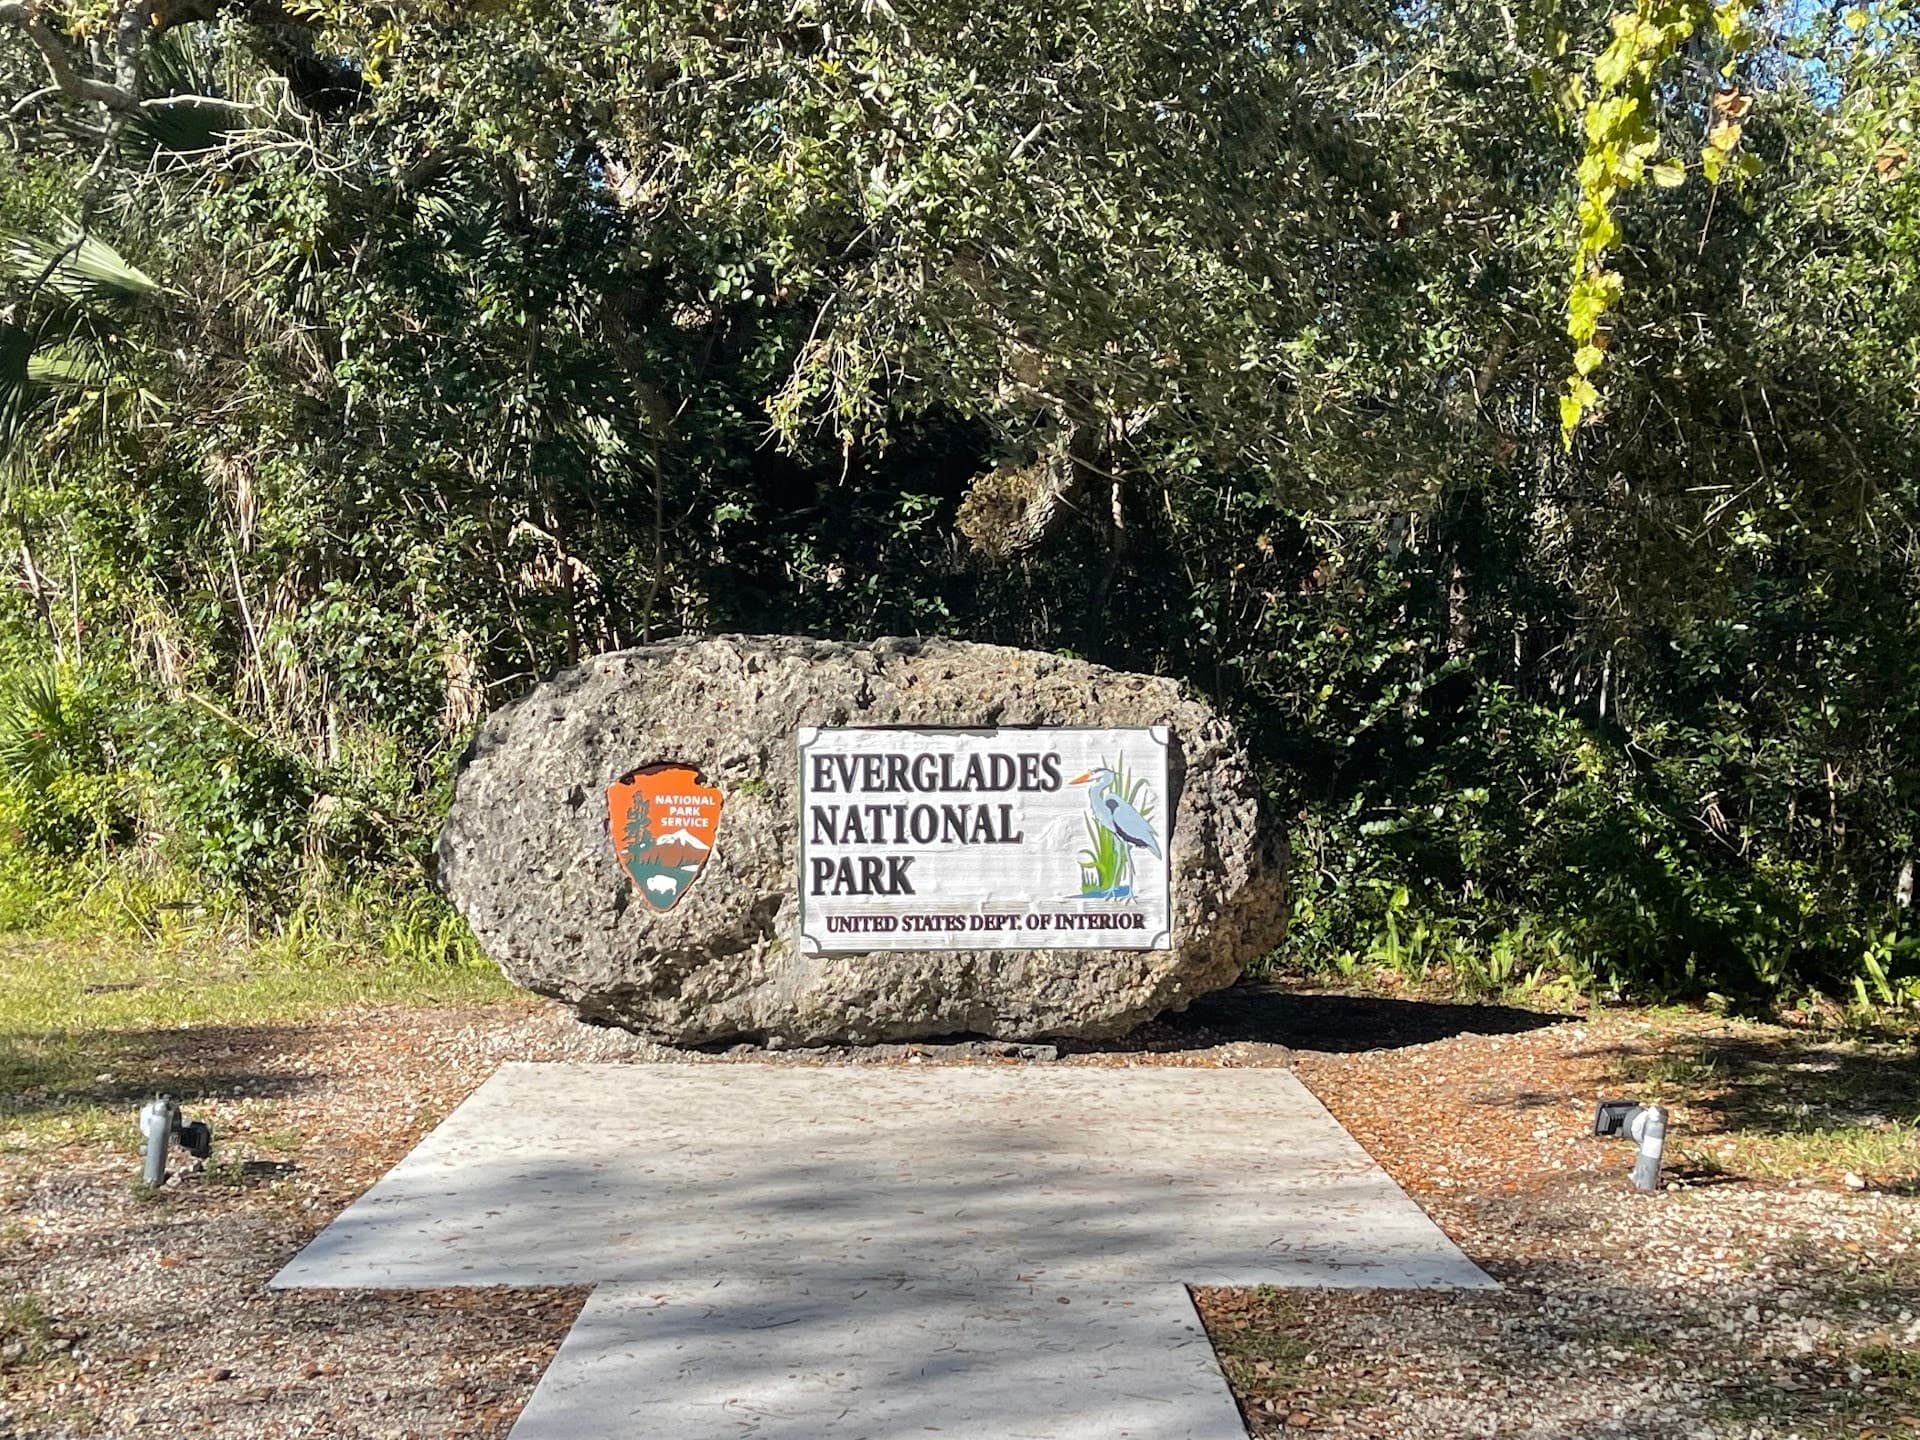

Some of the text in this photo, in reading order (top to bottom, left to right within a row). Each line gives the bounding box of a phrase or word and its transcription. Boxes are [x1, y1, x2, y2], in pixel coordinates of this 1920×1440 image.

[810, 752, 1063, 793] EVERGLADES
[655, 795, 715, 806] NATIONAL
[669, 806, 701, 816] PARK
[660, 817, 709, 828] SERVICE
[810, 803, 1024, 845] NATIONAL
[810, 855, 916, 896] PARK
[826, 914, 1146, 933] UNITED STATES DEPT. OF INTERIOR
